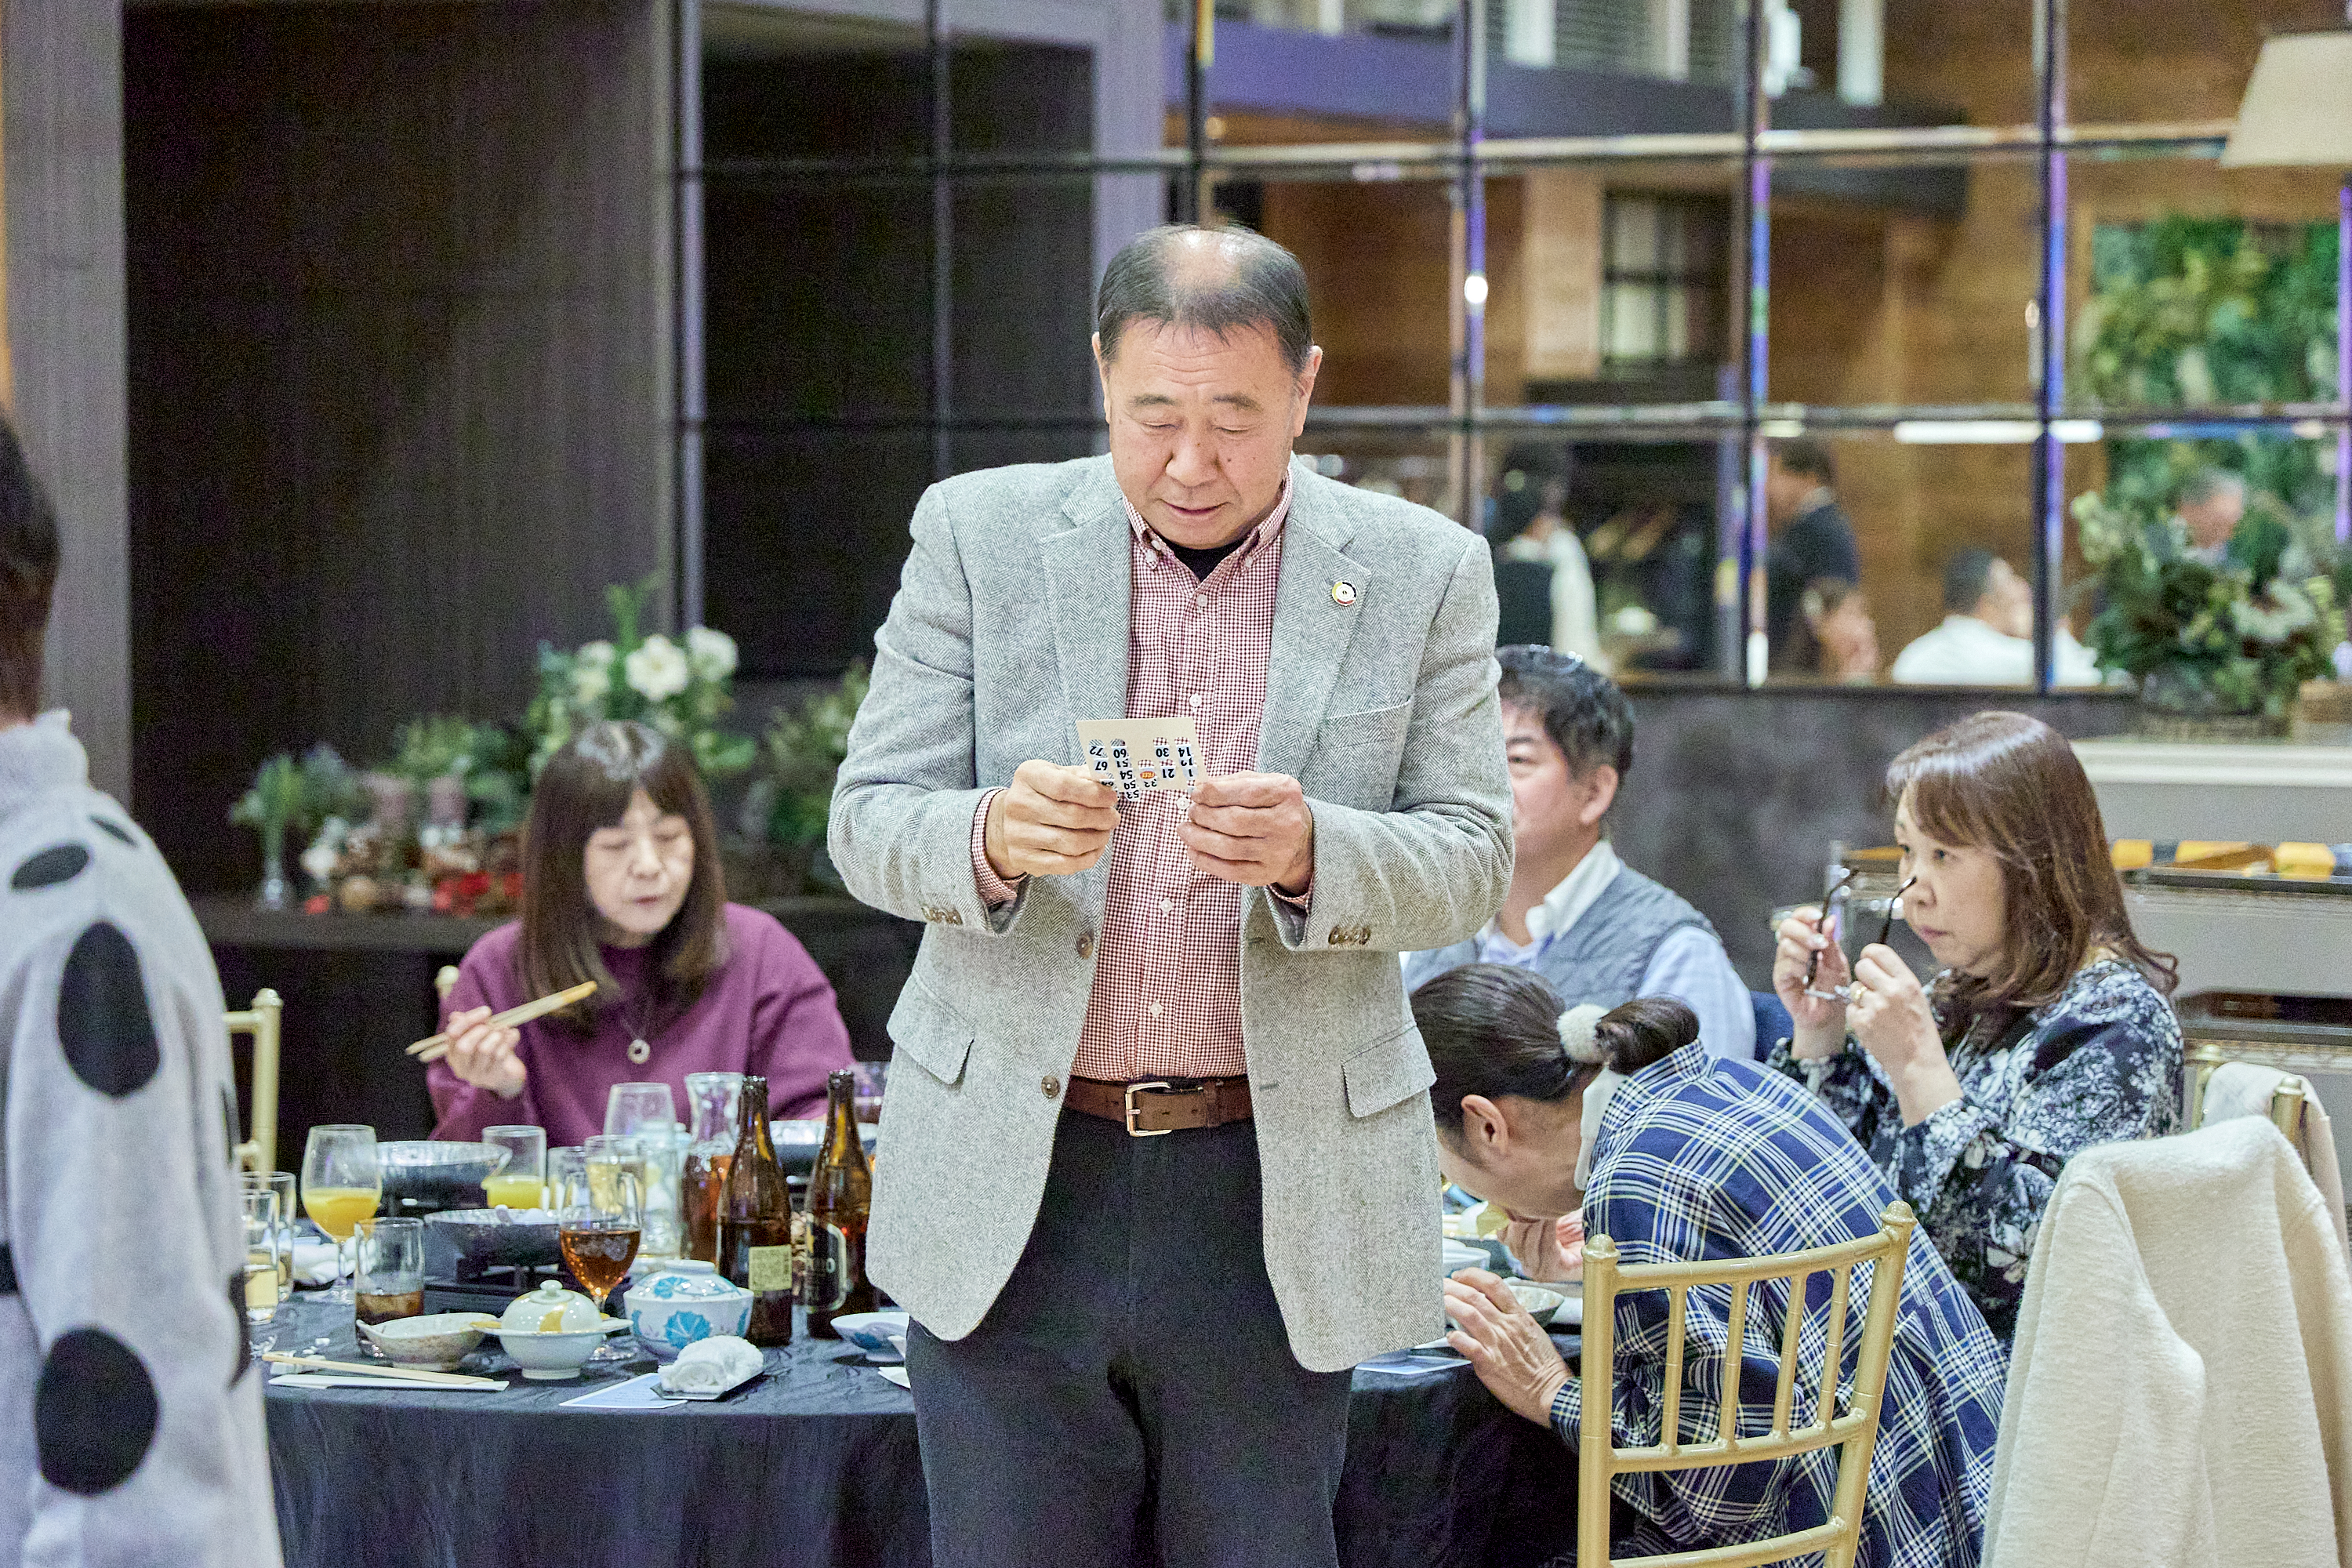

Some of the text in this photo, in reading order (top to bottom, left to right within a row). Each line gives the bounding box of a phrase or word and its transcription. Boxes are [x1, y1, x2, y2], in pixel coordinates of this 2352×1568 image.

[1089, 746, 1104, 757] 72
[1113, 748, 1127, 758] 60
[1156, 747, 1170, 758] 30
[1178, 746, 1191, 757] 14
[1094, 761, 1108, 771] 67
[1116, 758, 1129, 768] 51
[1120, 770, 1133, 780] 54
[1162, 768, 1175, 779] 21
